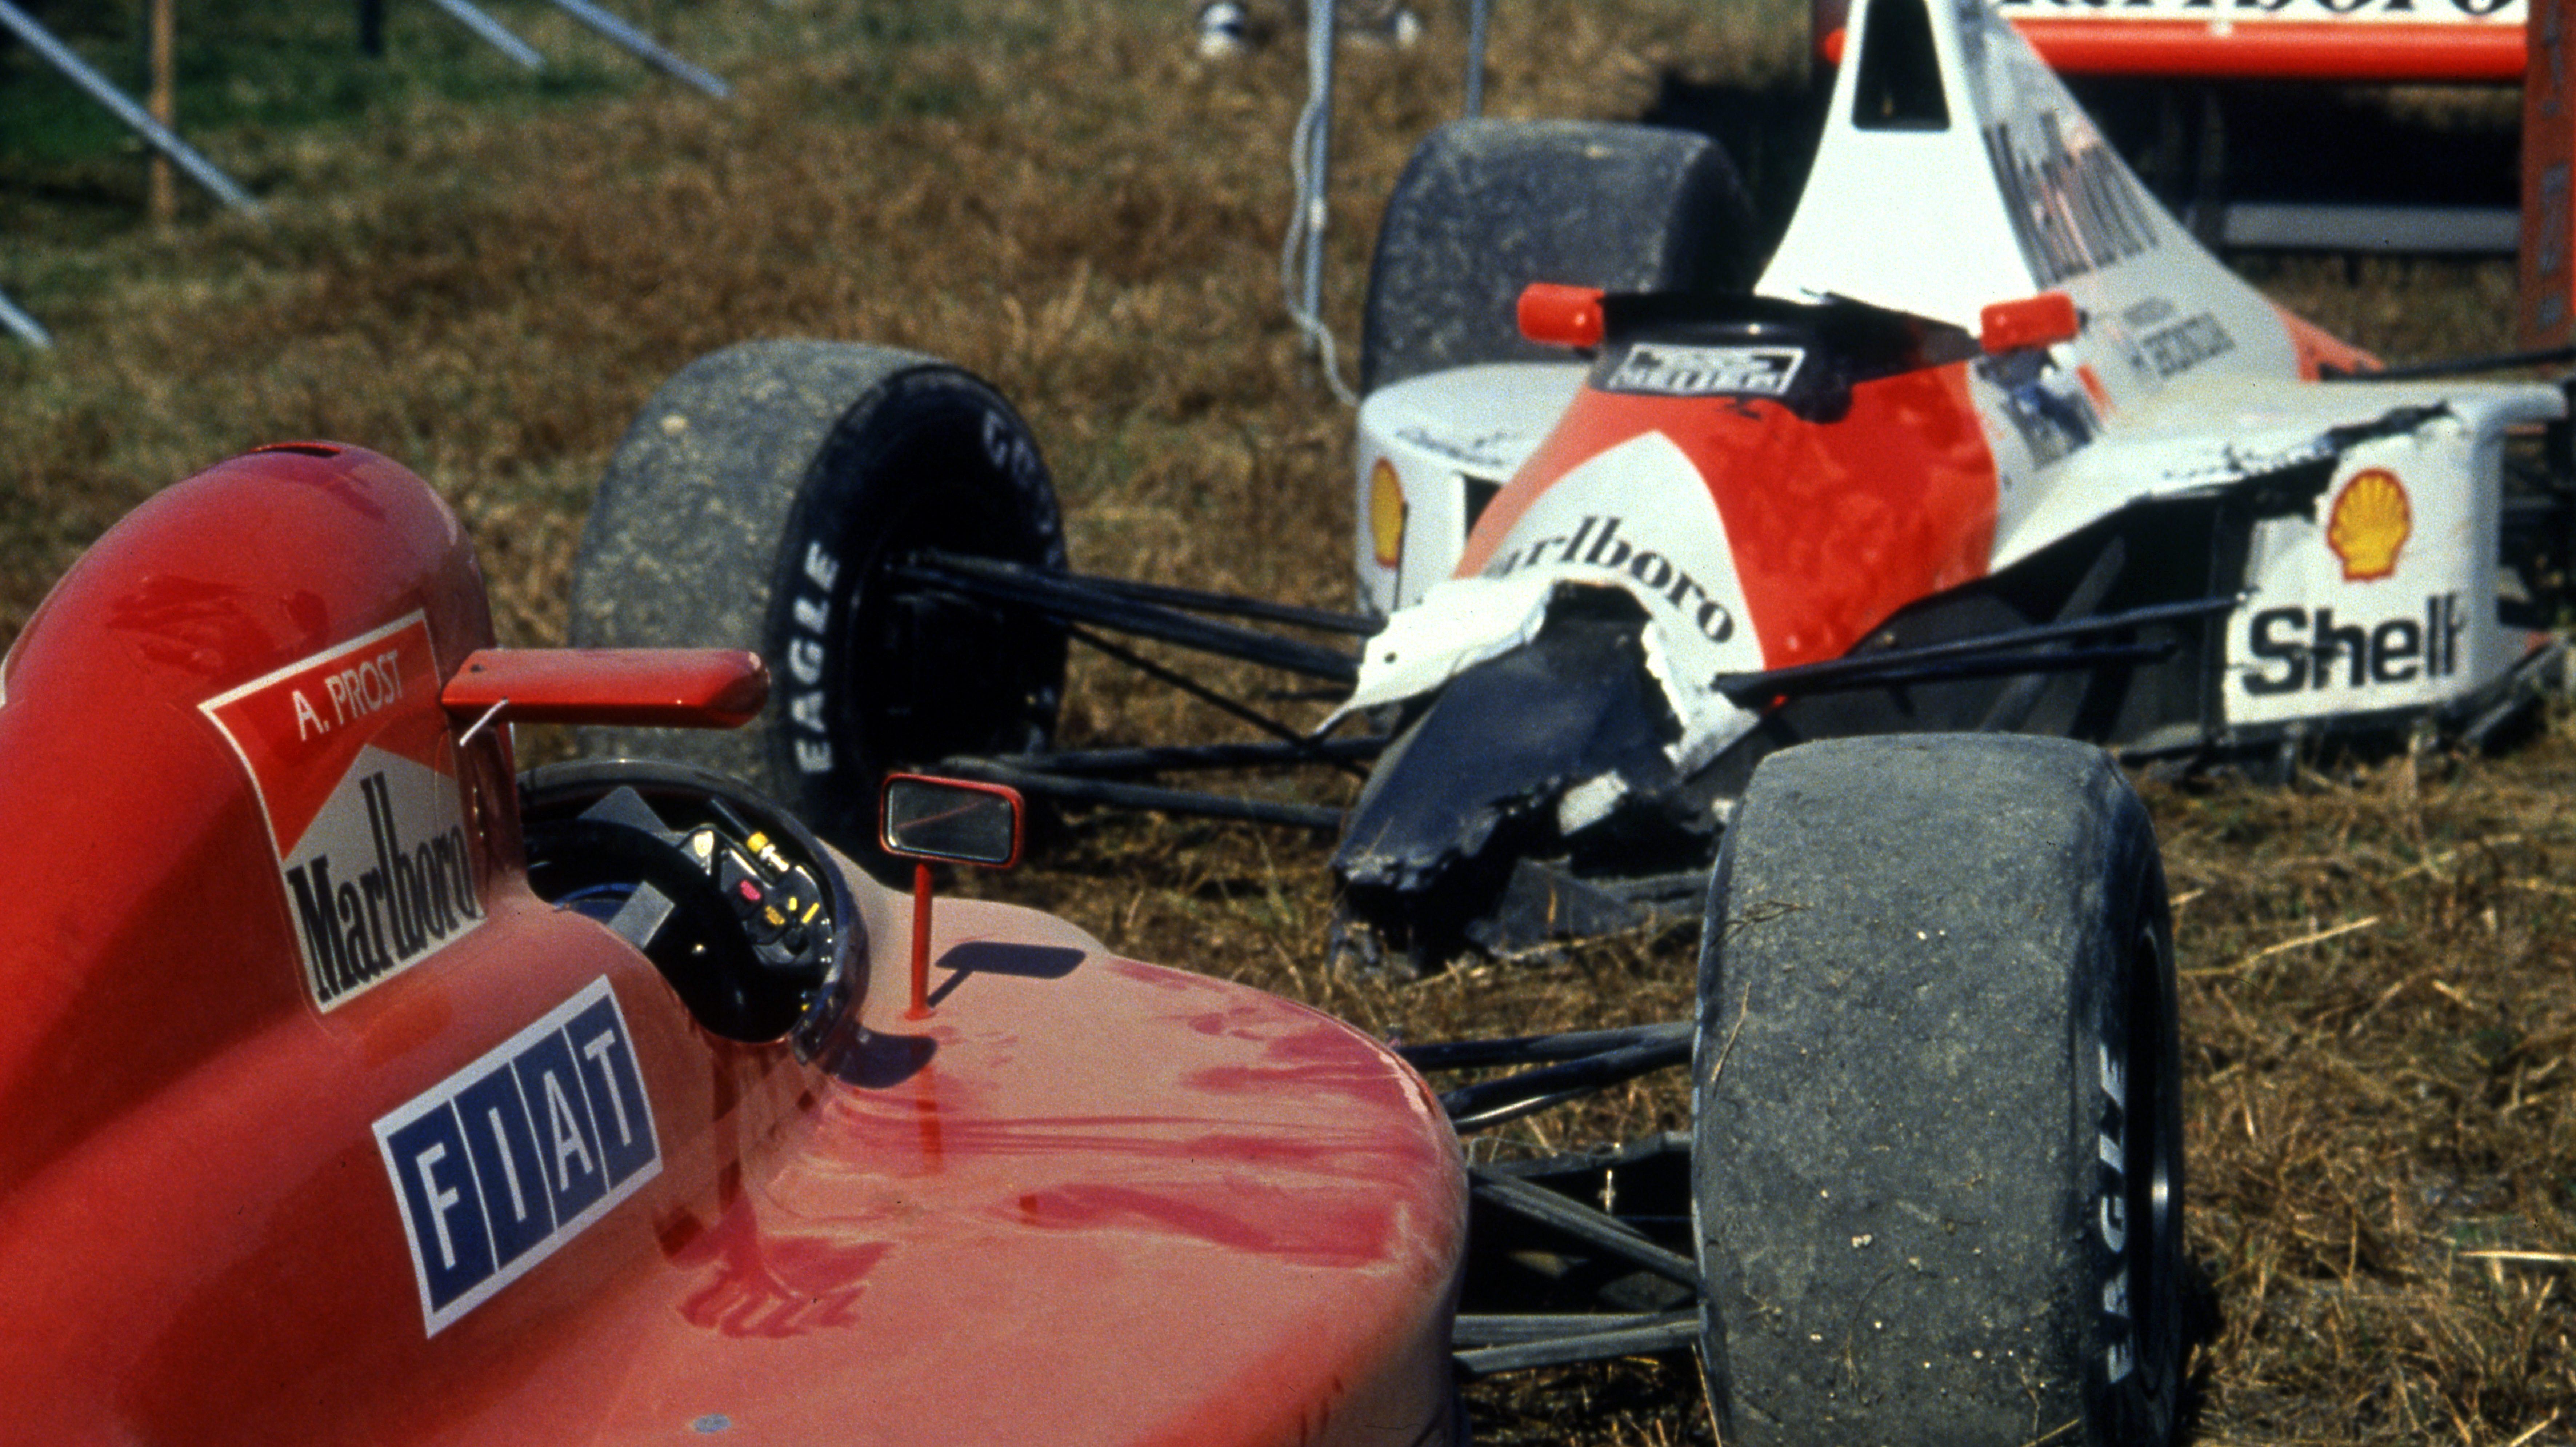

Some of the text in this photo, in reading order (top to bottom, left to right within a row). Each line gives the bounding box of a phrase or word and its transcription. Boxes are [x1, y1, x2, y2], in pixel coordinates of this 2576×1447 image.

[292, 649, 402, 741] A. PROST
[788, 541, 839, 773] EAGLE
[2241, 593, 2455, 698] Shell
[286, 771, 478, 1003] Marlboro
[416, 1028, 632, 1270] FIAT
[2100, 1043, 2133, 1382] EAGLE
